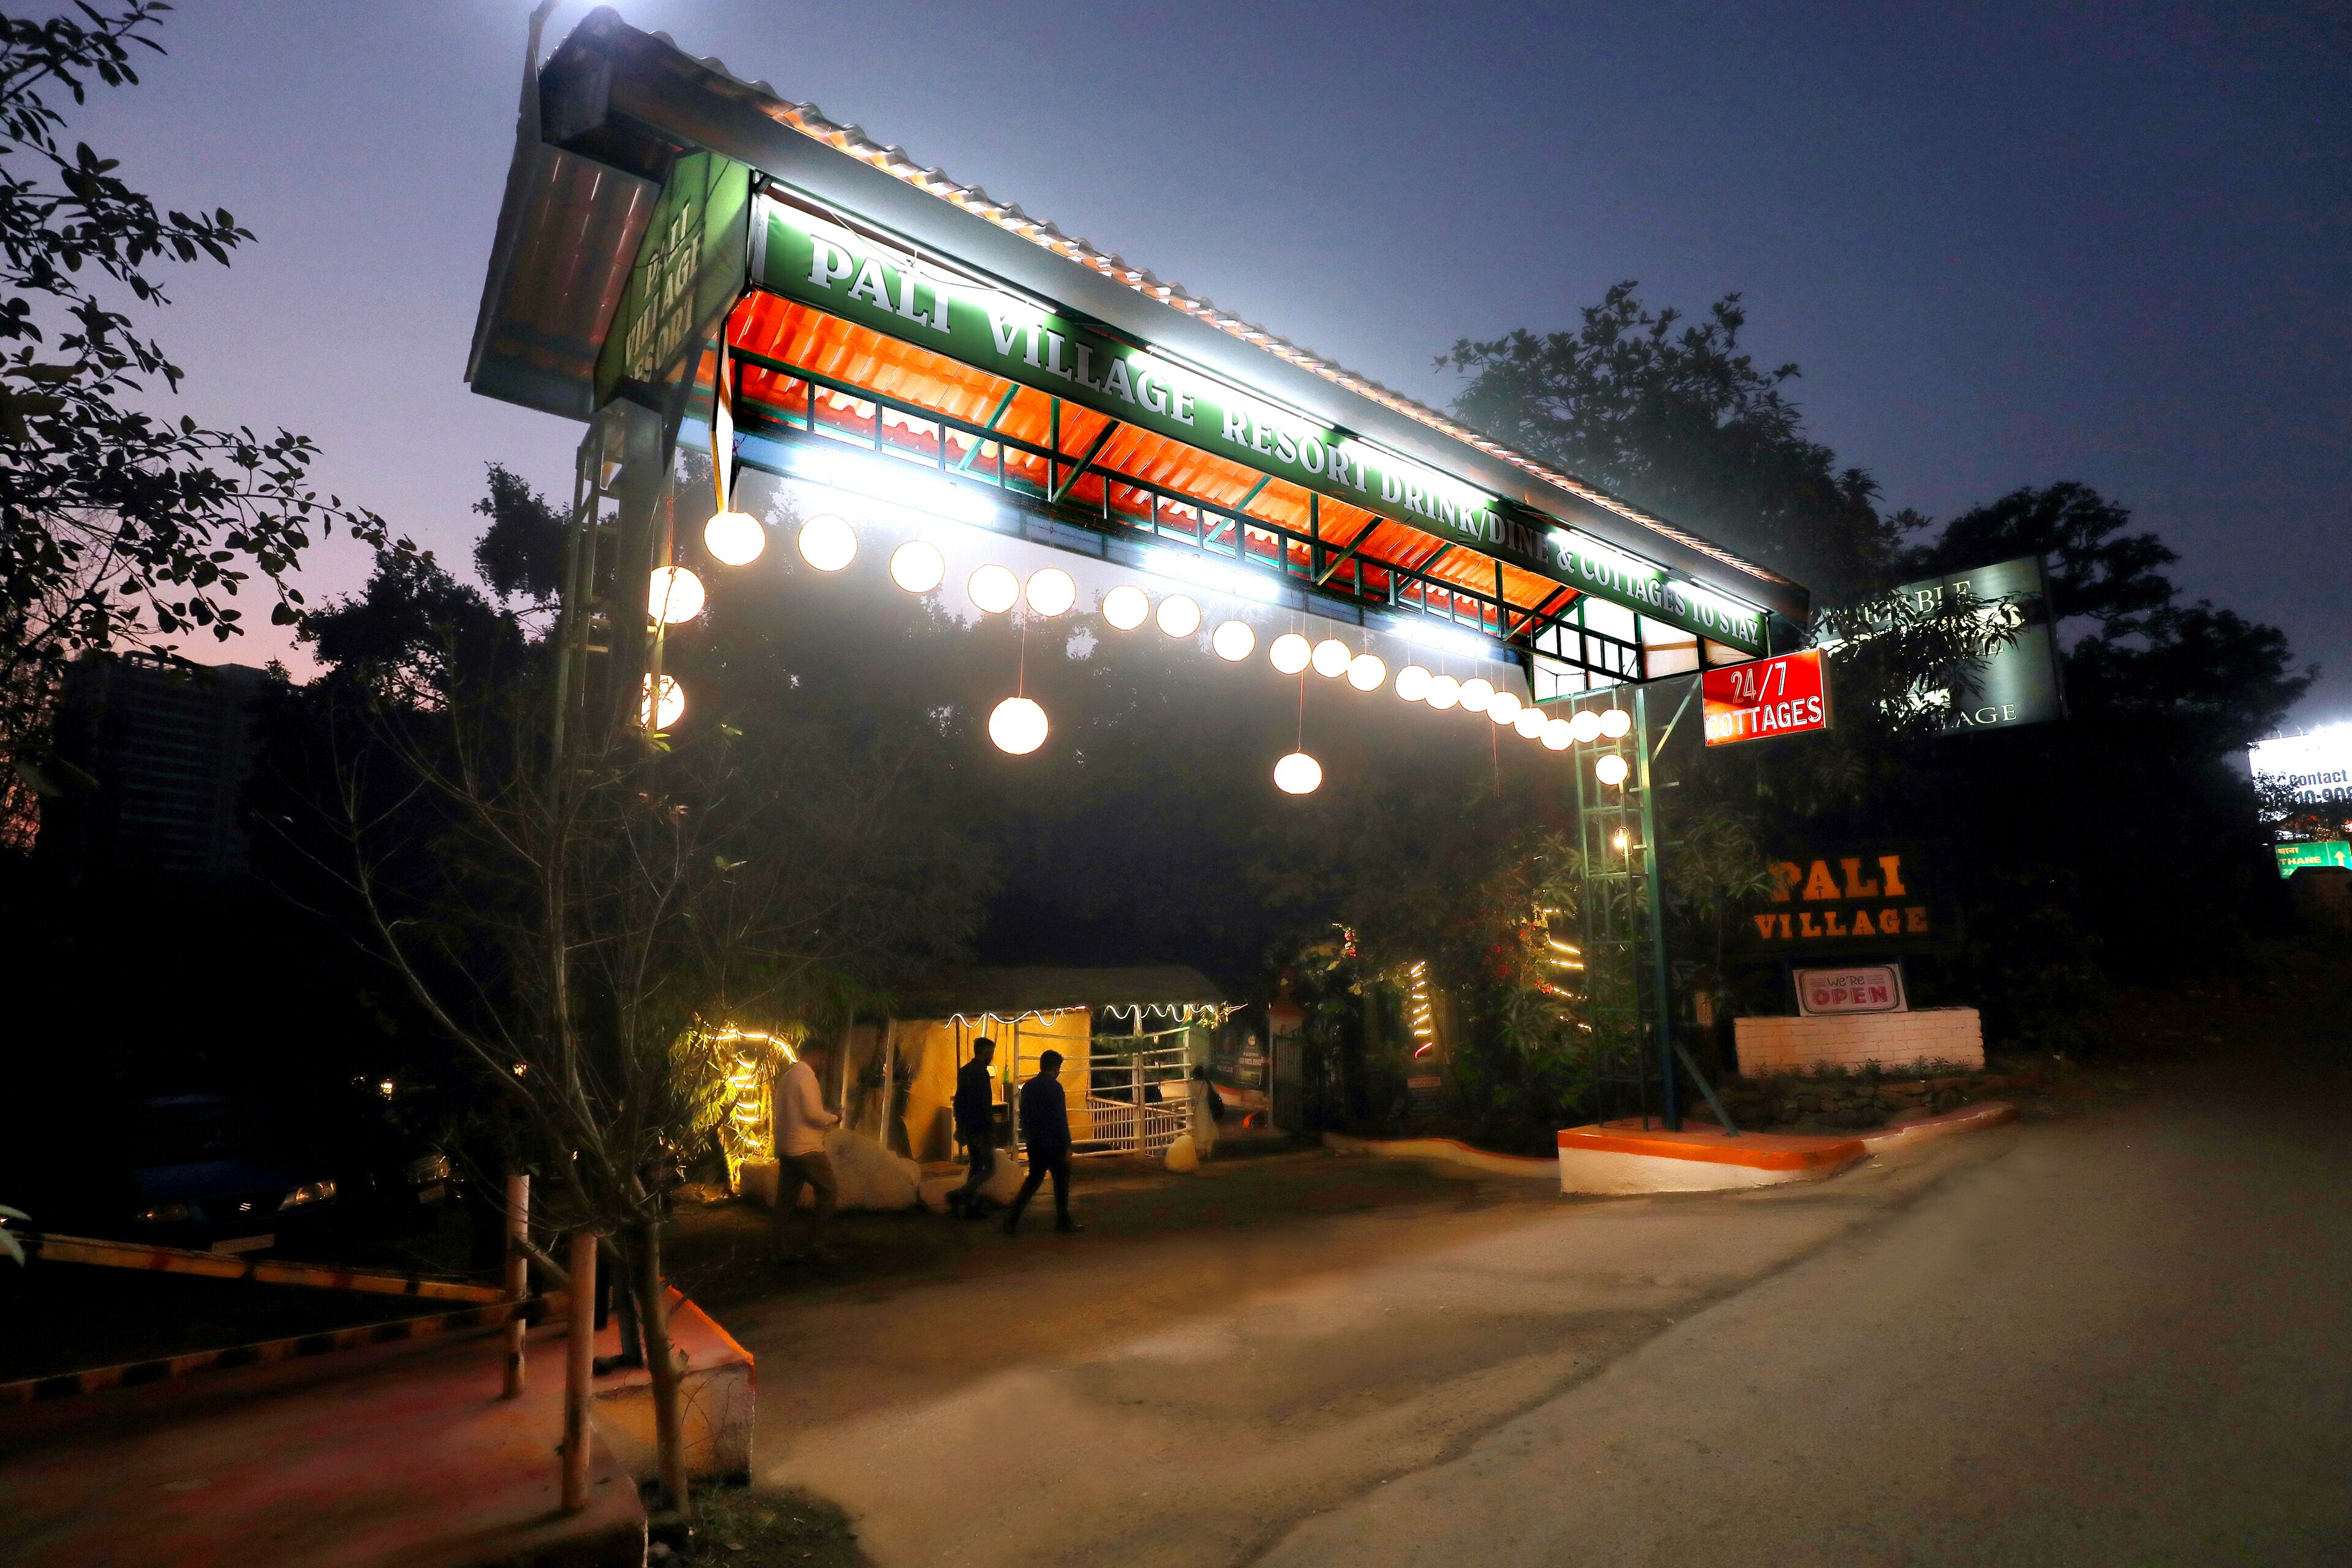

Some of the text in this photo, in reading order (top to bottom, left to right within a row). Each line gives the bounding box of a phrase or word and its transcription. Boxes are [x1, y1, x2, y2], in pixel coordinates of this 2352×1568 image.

[807, 233, 1758, 646] PALI VILLAGE RESORT DRINK/DINE & COTTAGES TO STAY
[1731, 661, 1787, 704] 24/7
[1706, 695, 1823, 739] COTTAGES
[2290, 769, 2348, 786] Contact
[1768, 855, 1906, 902] PALI
[2279, 856, 2322, 865] THANE
[1754, 907, 1929, 938] VILLAGE
[1812, 986, 1888, 1006] OPEN
